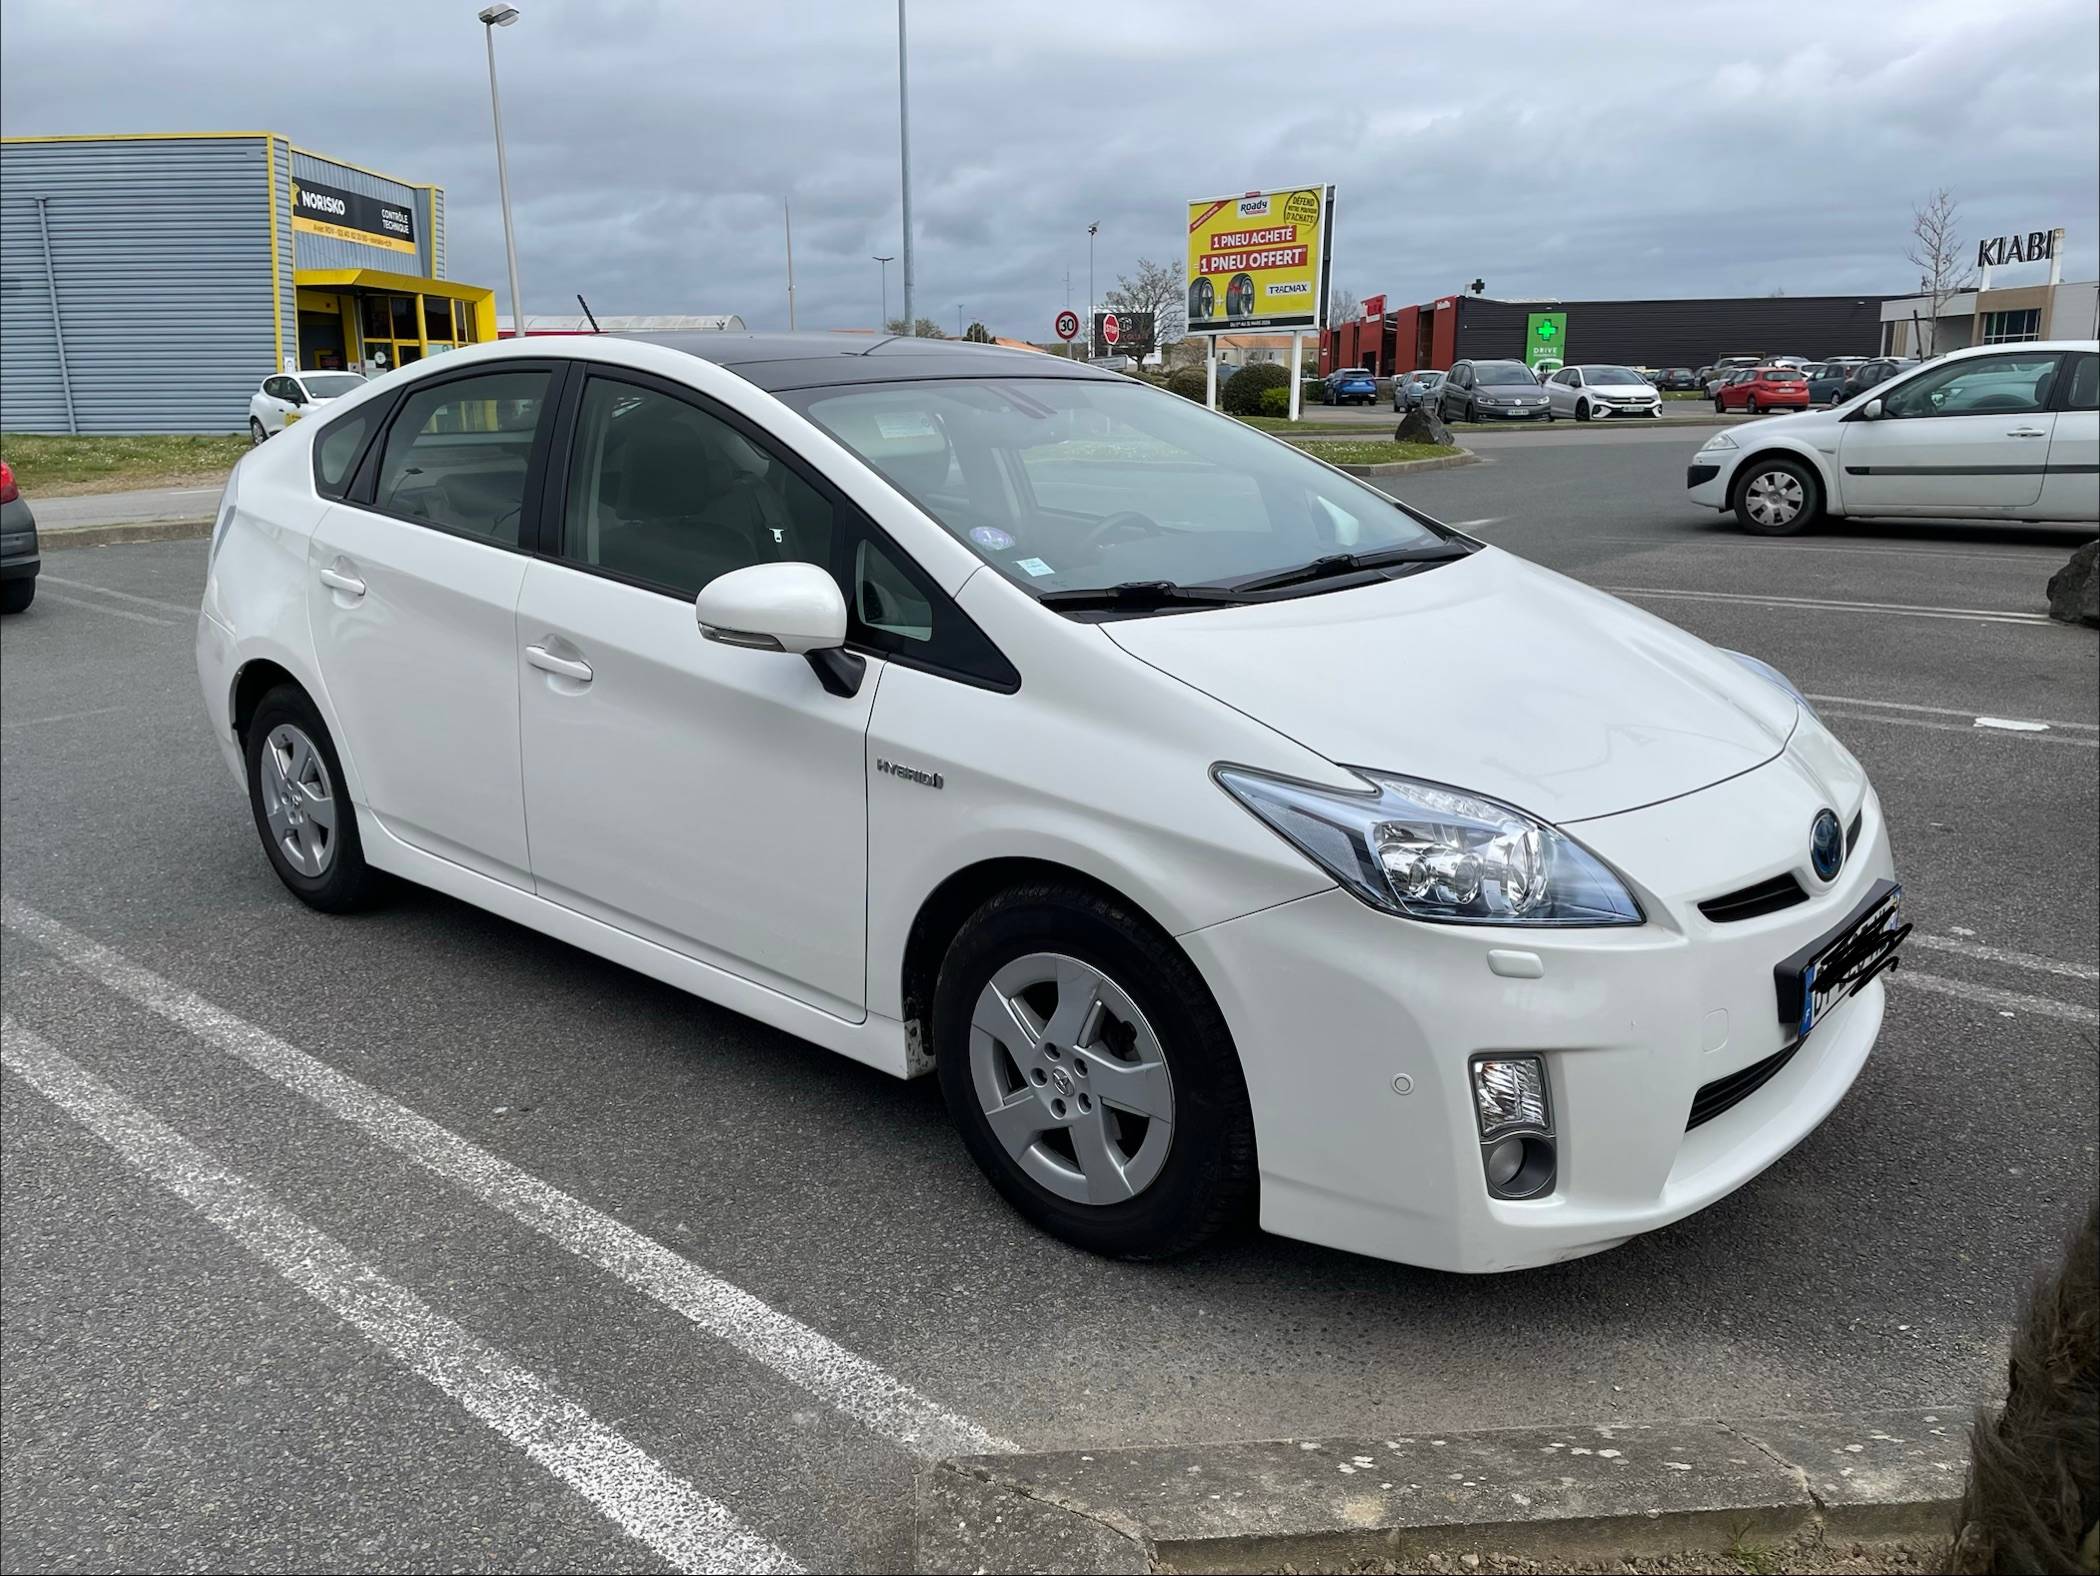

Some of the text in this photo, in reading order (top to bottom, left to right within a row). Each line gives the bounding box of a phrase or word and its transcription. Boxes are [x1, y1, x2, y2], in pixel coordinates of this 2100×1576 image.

[302, 190, 345, 215] NORISKO
[381, 208, 408, 224] CONTRÔLE
[382, 219, 409, 234] TECHNIQUE
[1213, 226, 1293, 248] 1 PNEU ACHETÉ
[1978, 230, 2054, 267] KIABI
[1200, 260, 1208, 272] 1
[1211, 255, 1246, 271] PNEU
[1269, 284, 1307, 294] TRACMAX
[1060, 318, 1074, 332] 30
[1105, 324, 1118, 334] STOP
[876, 758, 932, 787] HYBRID
